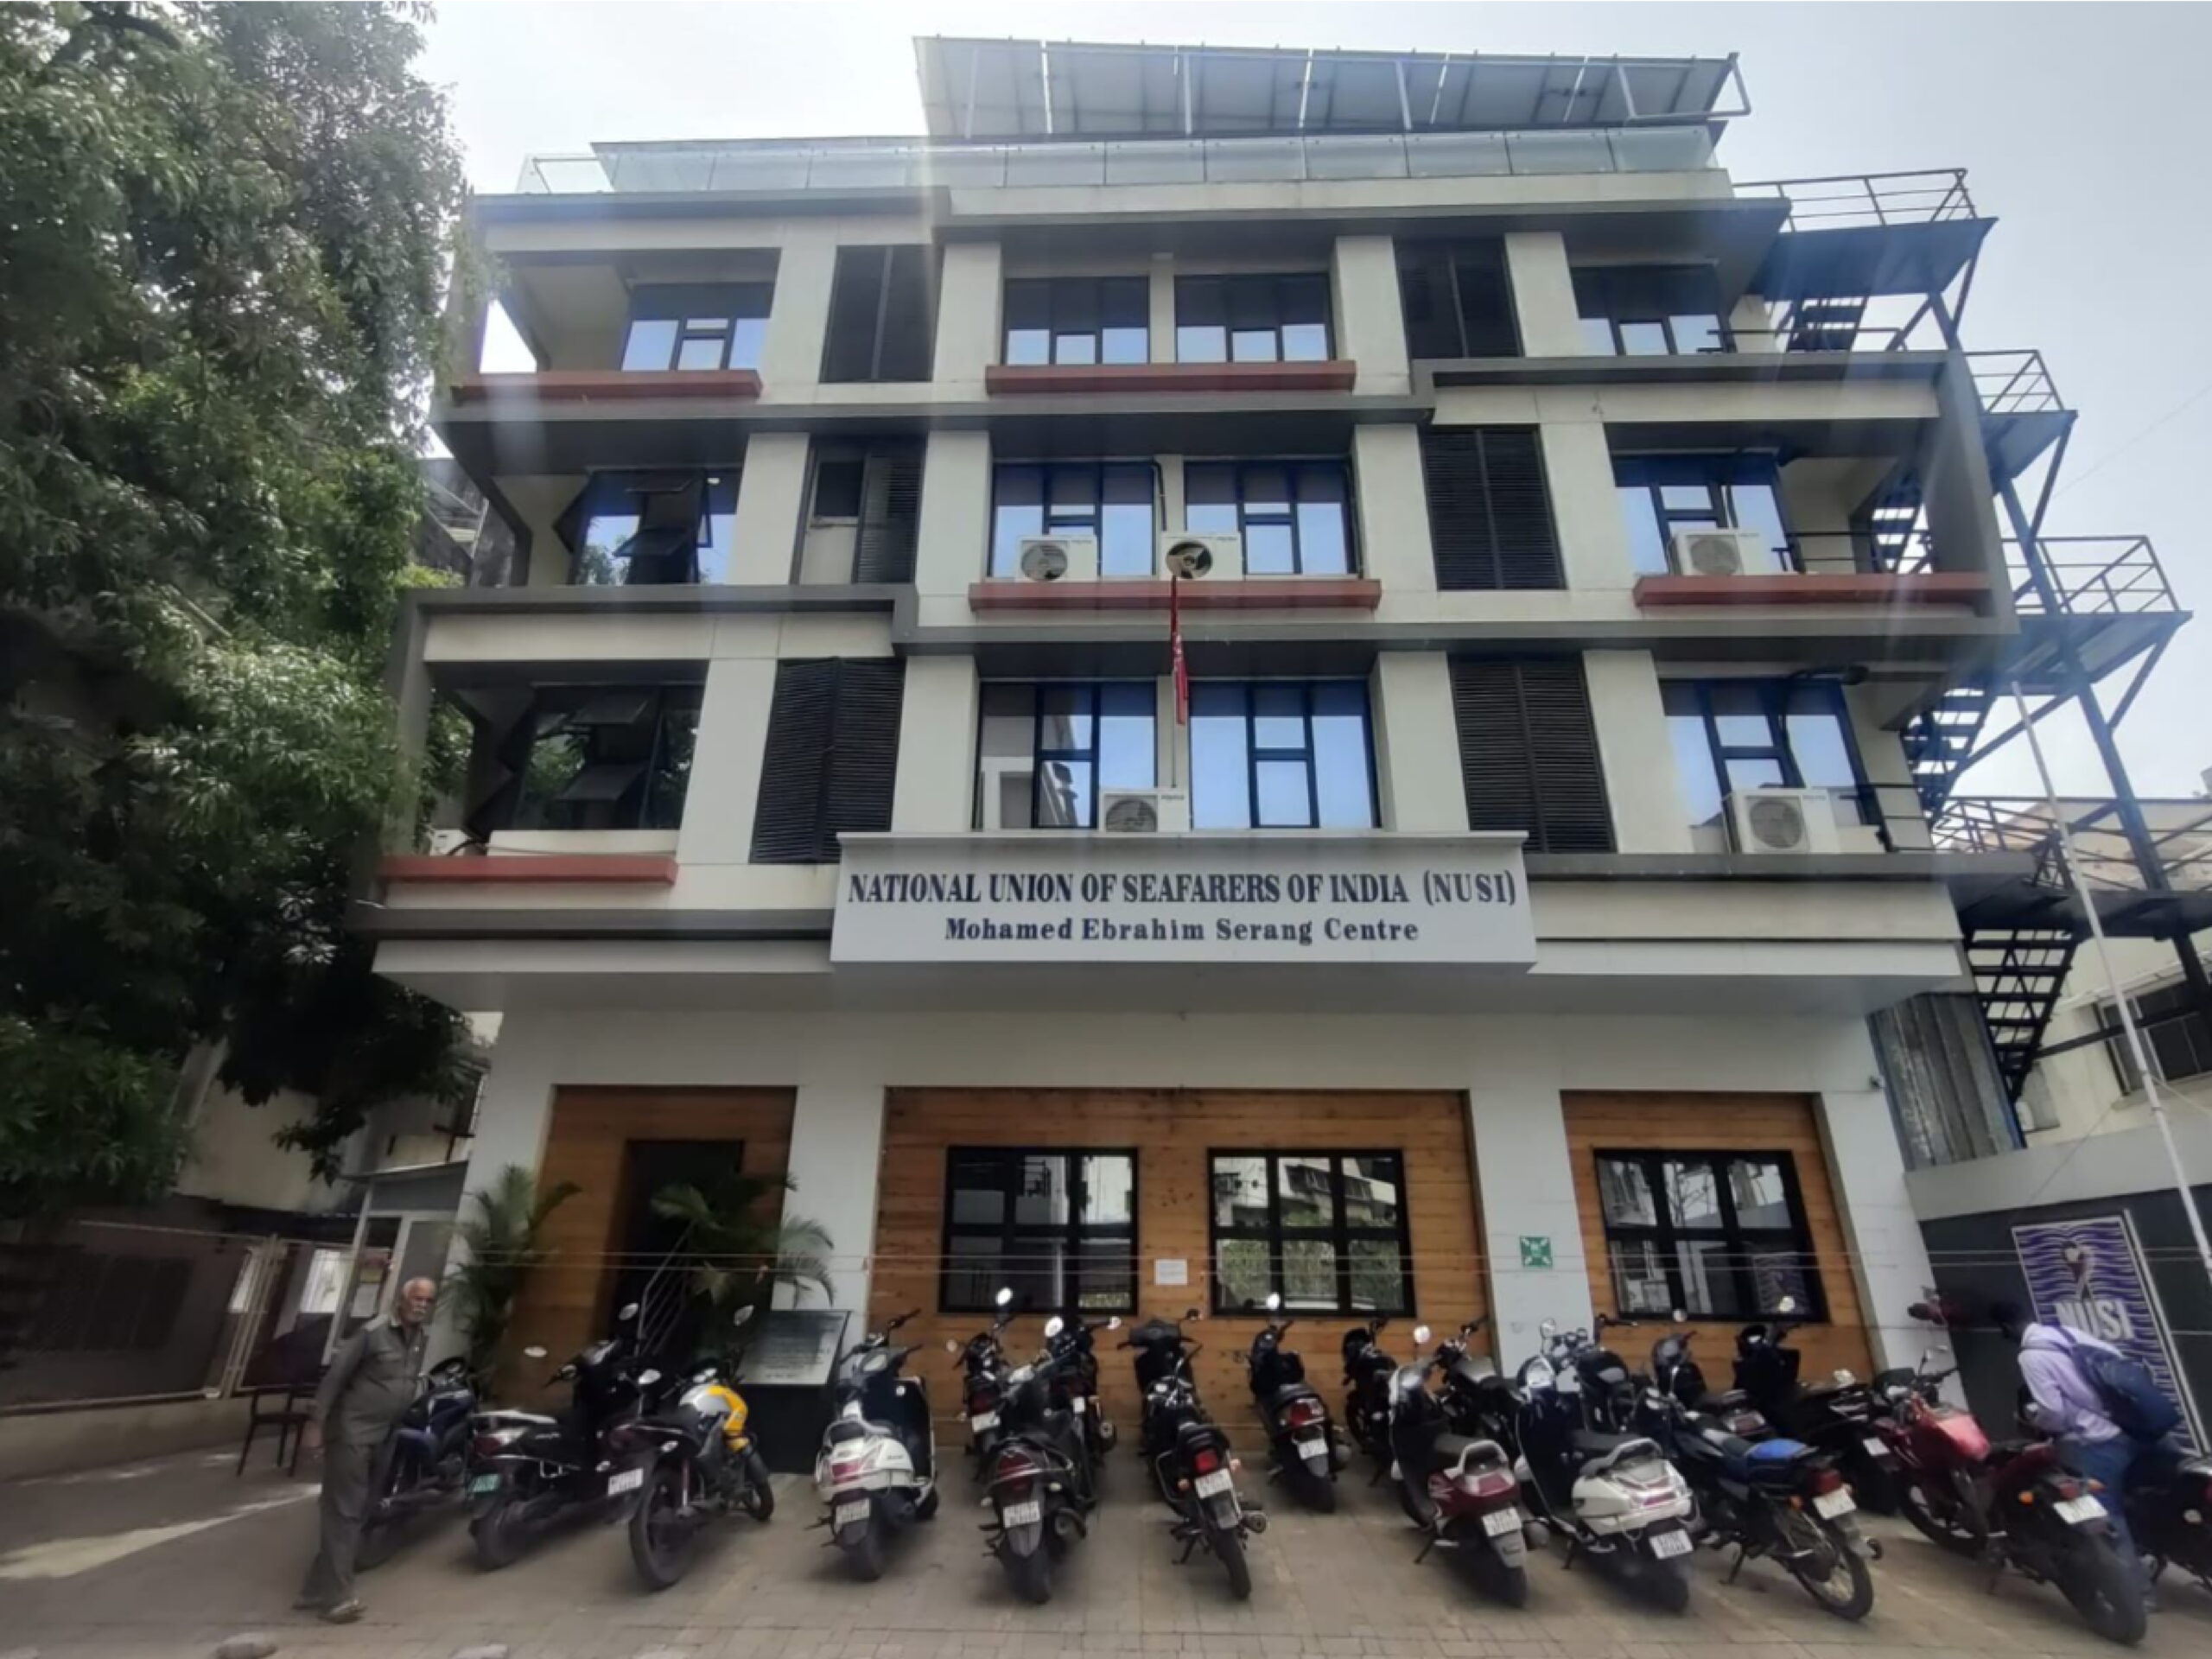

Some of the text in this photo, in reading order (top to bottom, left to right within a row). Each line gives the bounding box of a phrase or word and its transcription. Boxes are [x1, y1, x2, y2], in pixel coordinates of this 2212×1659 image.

[849, 869, 1516, 906] NATIONAL UNION OF SEAFARERS OF INDIA (NUSI)
[945, 918, 1419, 945] Mohamed Ebrahim Serang Centre
[2053, 1298, 2135, 1341] NUSI
